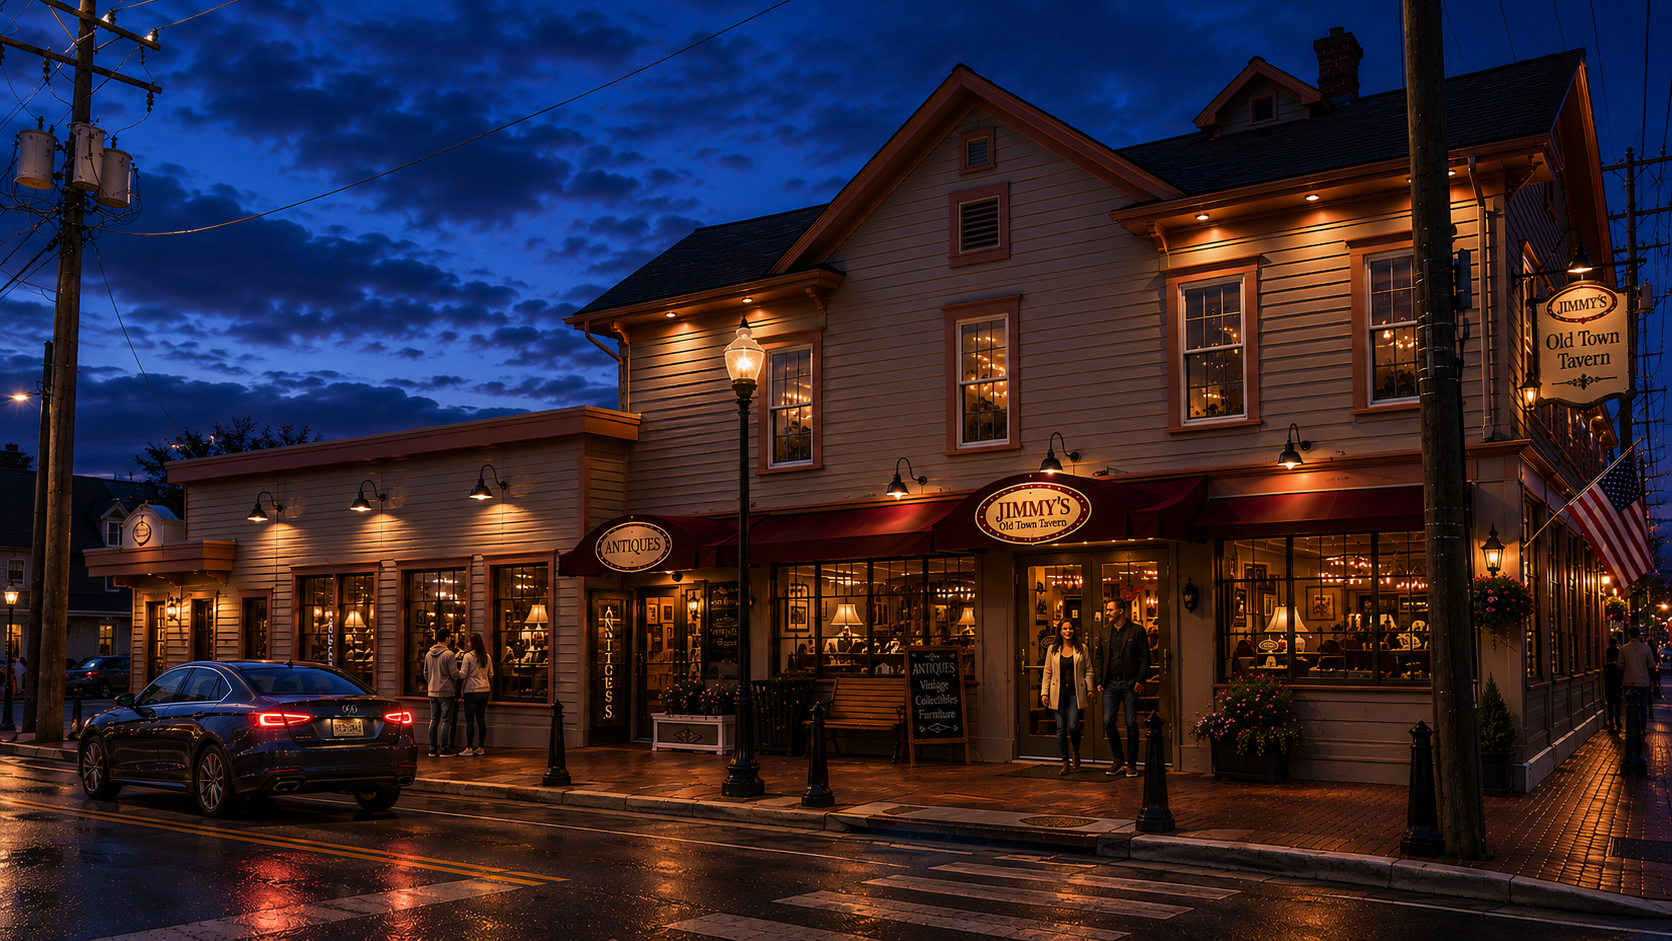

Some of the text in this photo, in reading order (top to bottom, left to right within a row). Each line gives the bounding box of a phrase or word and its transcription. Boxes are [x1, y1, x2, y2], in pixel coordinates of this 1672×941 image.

[1557, 295, 1607, 315] JIMMY'S
[1546, 330, 1620, 350] Old Town
[1557, 352, 1611, 370] Tavern
[996, 496, 1070, 522] JIMMY'S
[1000, 519, 1067, 531] Old Town Tavern
[605, 537, 660, 555] ANTIQUES
[912, 662, 955, 676] ANTIQUES
